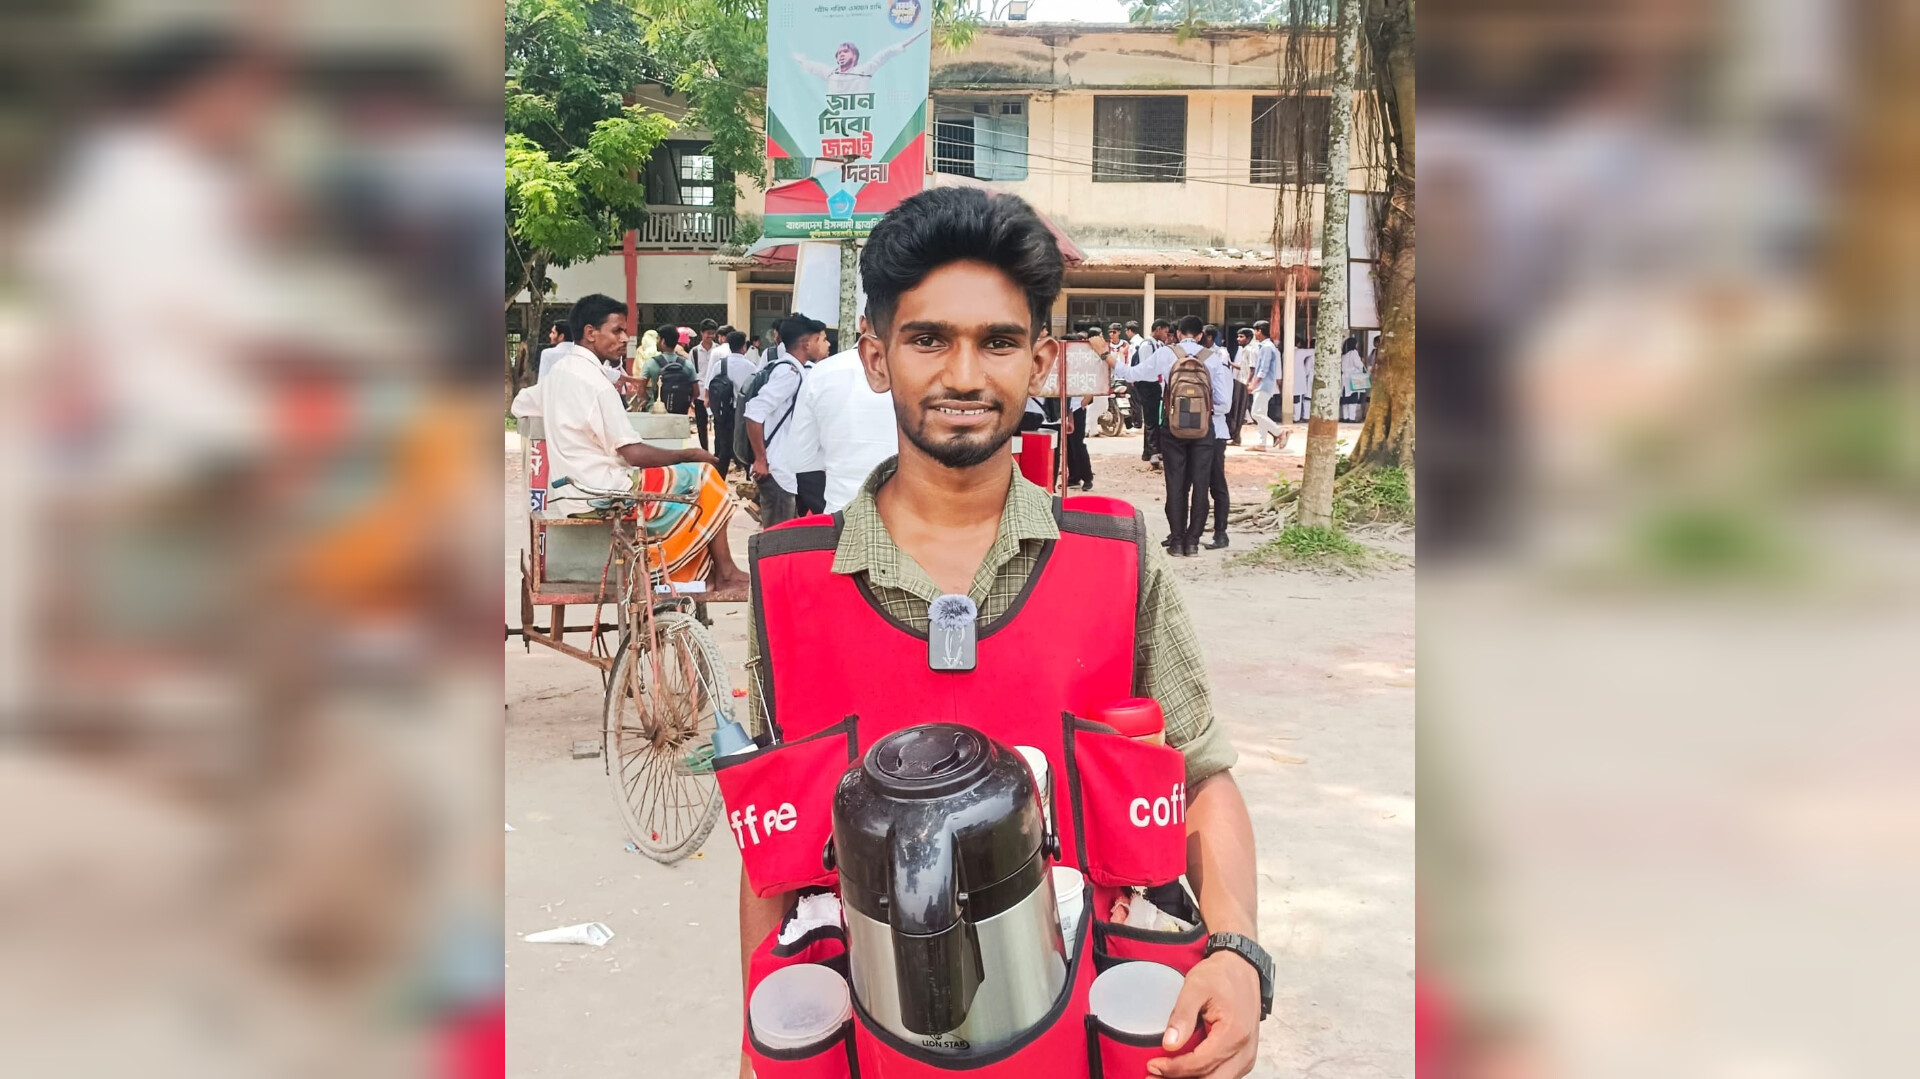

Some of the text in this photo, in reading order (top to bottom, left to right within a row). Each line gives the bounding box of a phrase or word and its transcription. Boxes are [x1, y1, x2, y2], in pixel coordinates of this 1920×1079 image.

[826, 92, 875, 111] জান
[818, 107, 871, 136] দিবো
[785, 220, 822, 230] বাংলাদেশ
[823, 218, 854, 230] ইসলামী
[922, 1040, 966, 1049] LION STAR
